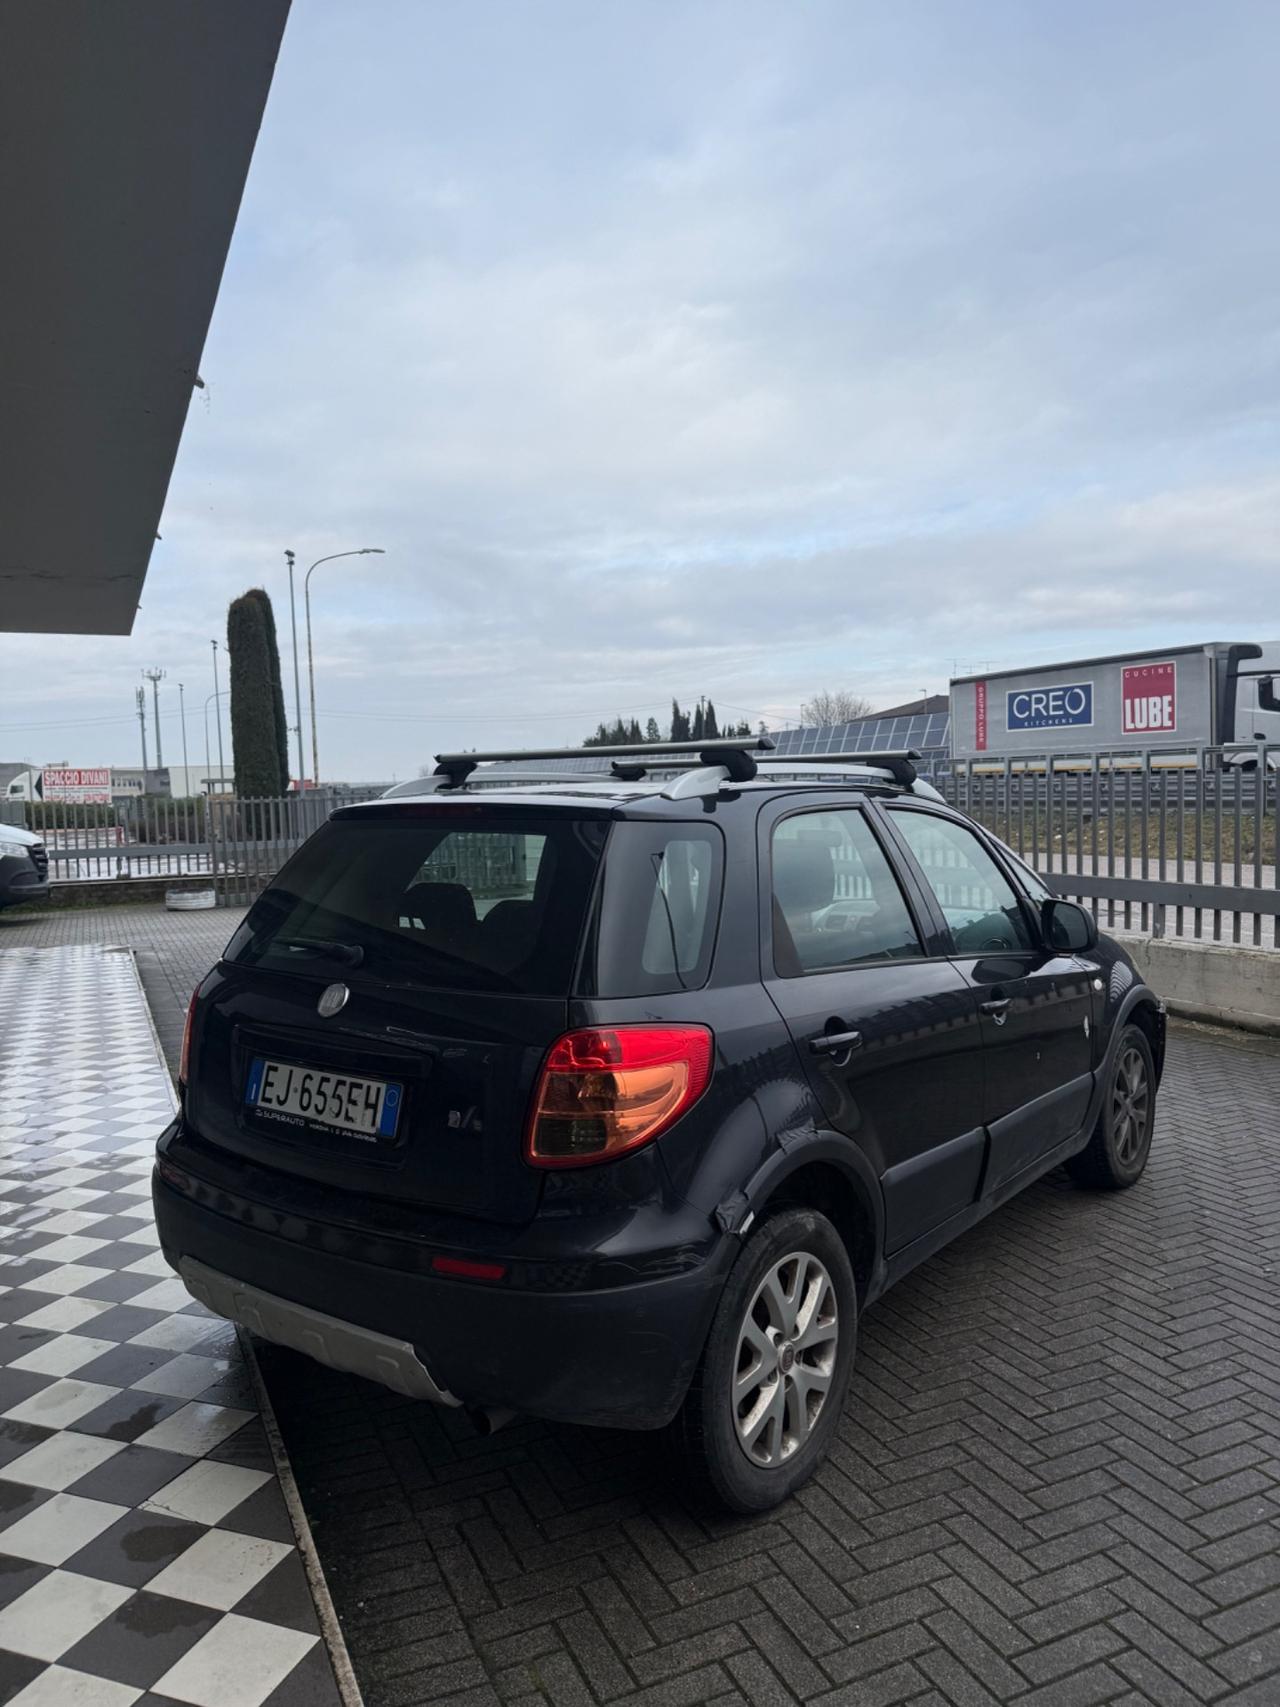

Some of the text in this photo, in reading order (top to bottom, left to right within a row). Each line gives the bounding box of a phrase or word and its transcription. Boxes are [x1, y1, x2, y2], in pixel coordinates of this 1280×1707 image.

[1124, 666, 1172, 678] CUCINE
[1013, 688, 1086, 718] CREO
[1125, 695, 1173, 729] LUBE
[45, 770, 108, 785] SPACCIO DIVANI
